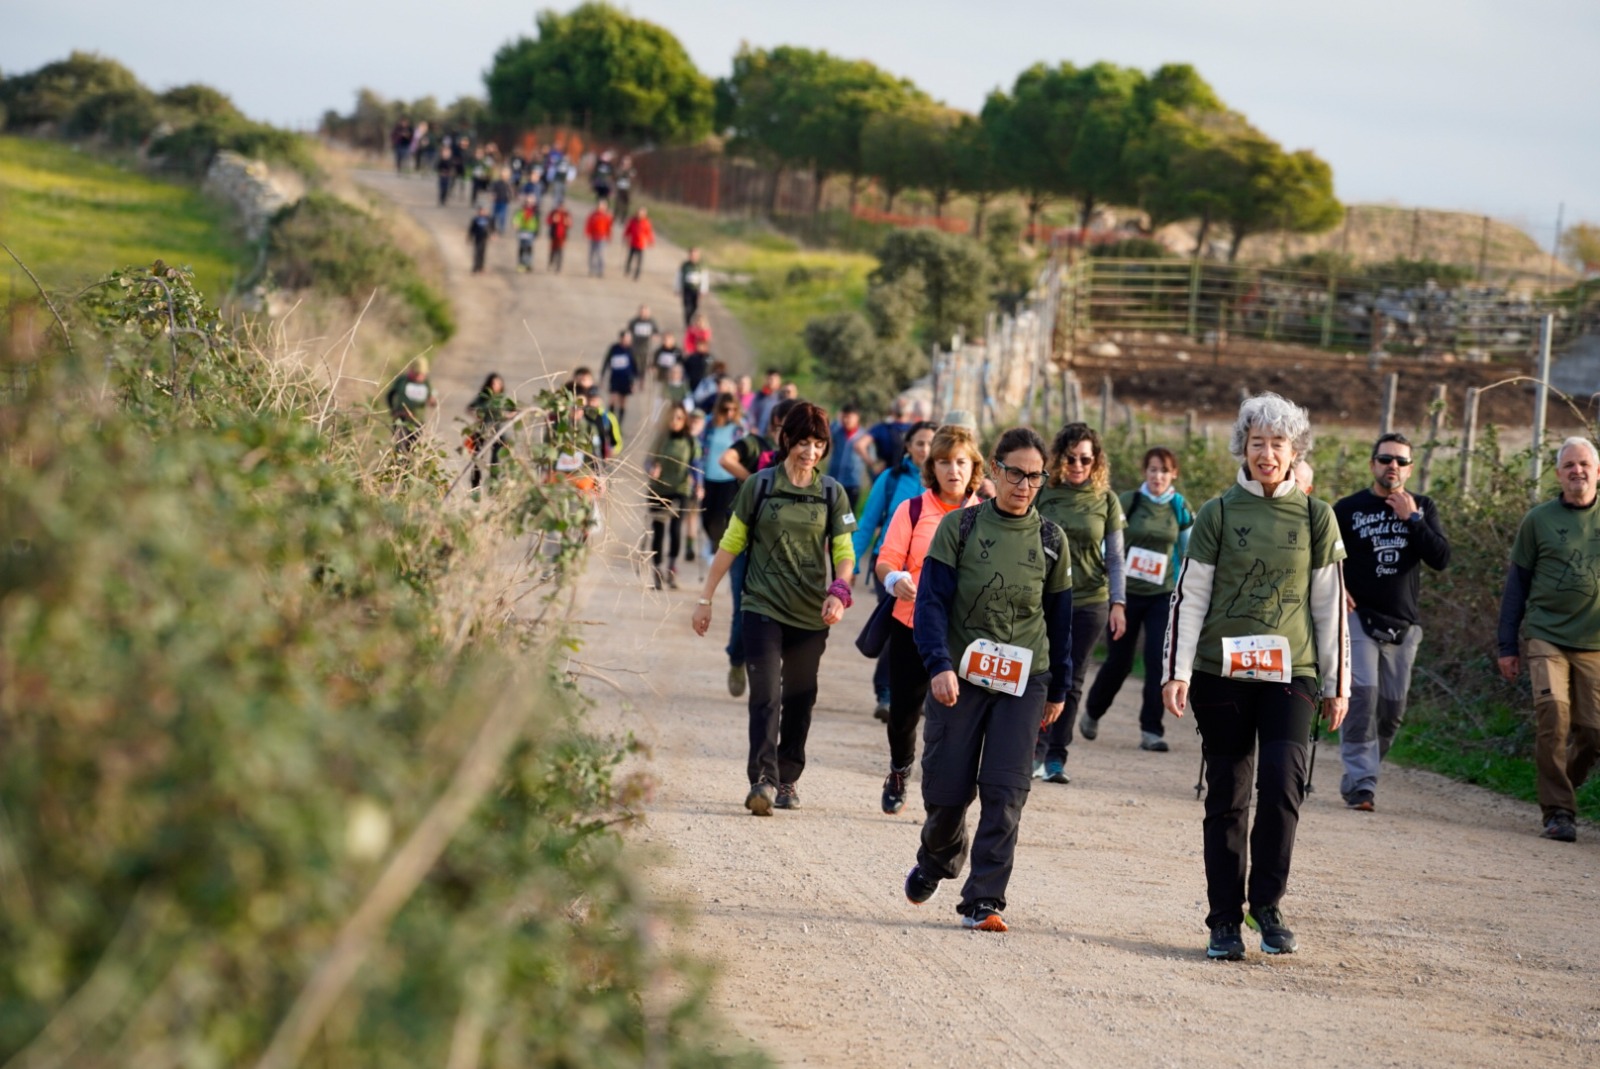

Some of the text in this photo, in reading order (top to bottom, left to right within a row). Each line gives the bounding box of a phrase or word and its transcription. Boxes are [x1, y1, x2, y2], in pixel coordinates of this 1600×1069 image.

[1360, 522, 1390, 539] World
[979, 655, 1011, 676] 615
[1241, 651, 1272, 667] 614
